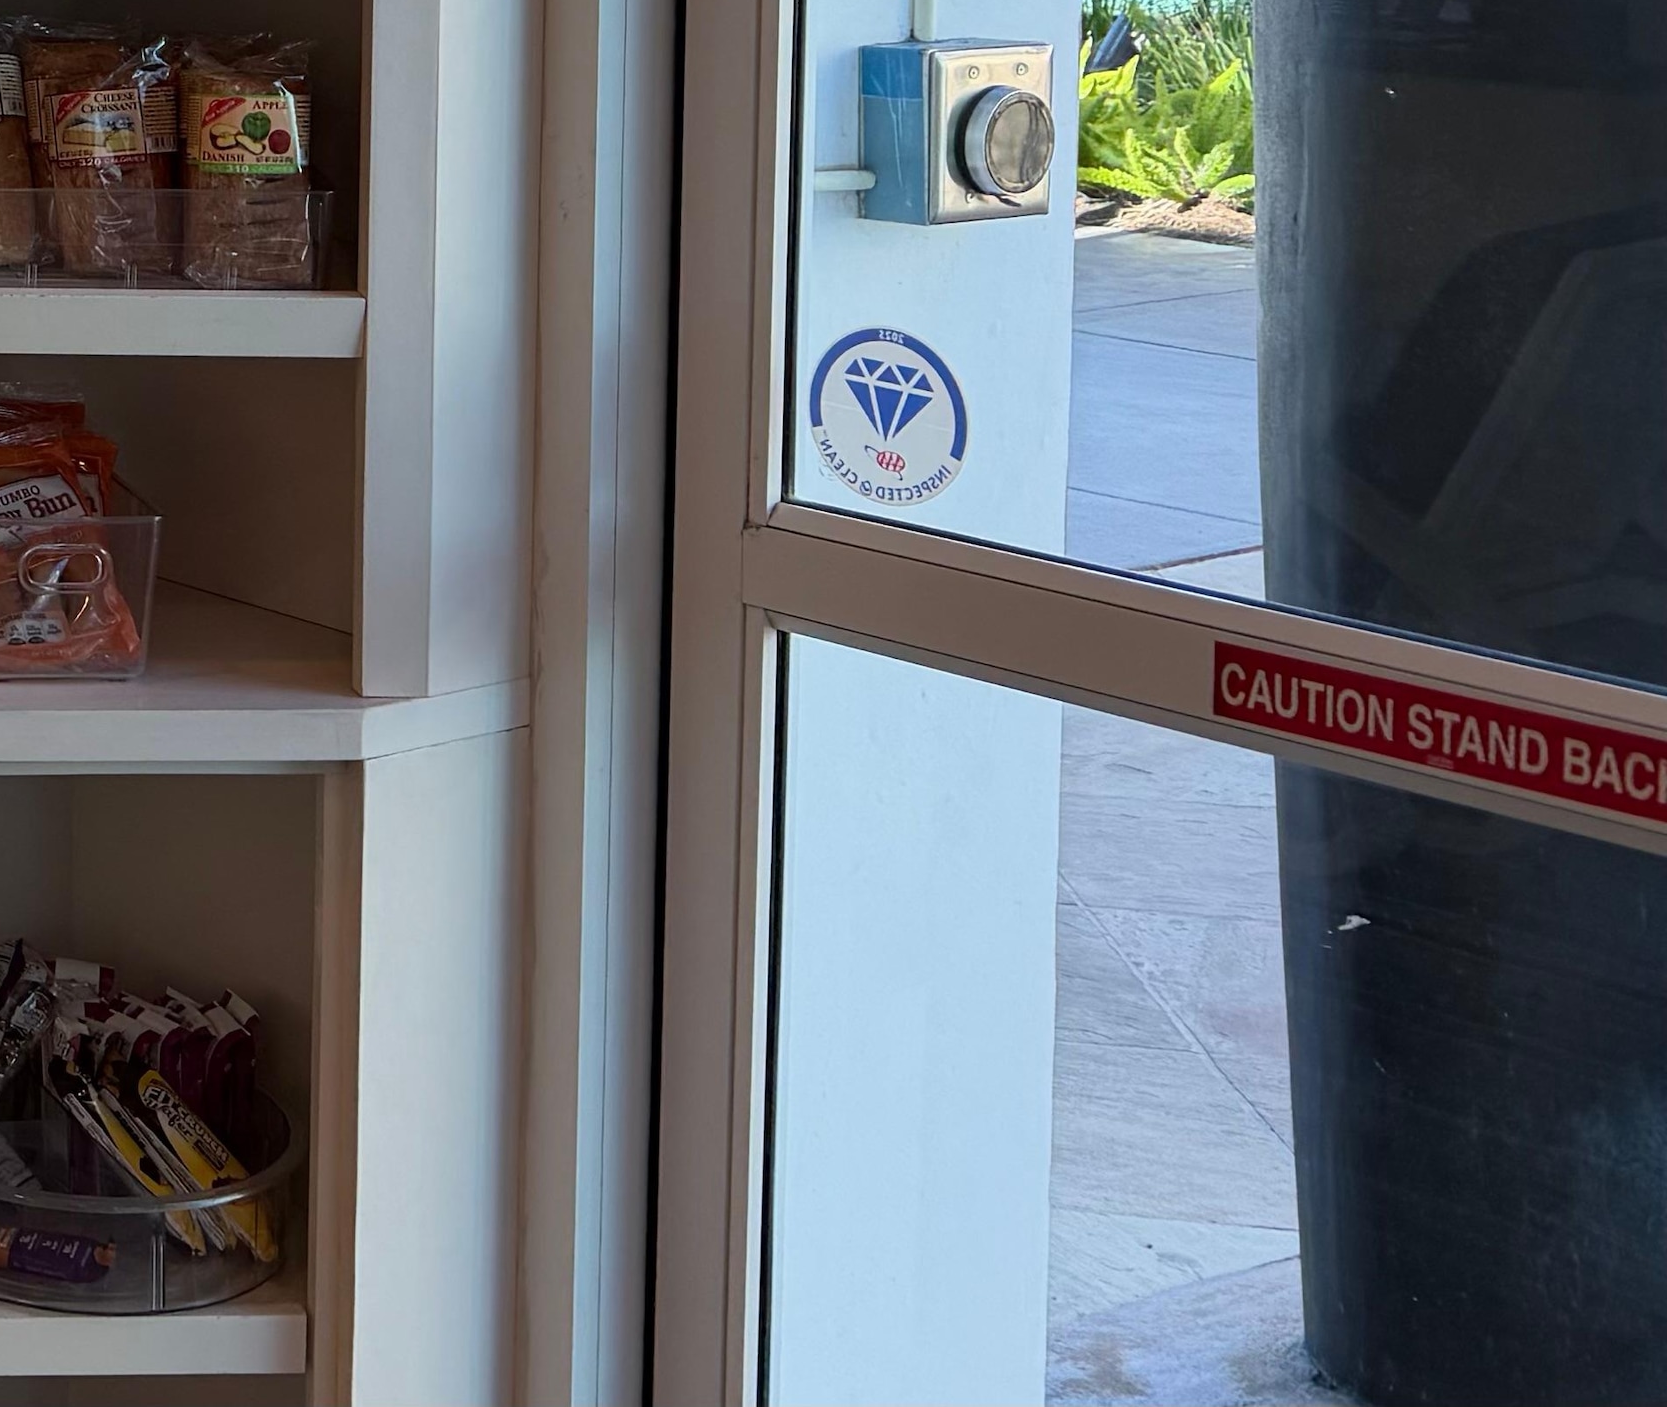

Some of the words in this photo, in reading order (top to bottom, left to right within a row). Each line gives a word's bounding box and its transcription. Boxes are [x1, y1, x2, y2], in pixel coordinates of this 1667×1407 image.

[94, 92, 135, 102] CHEESE
[81, 102, 138, 113] CROISSANT
[78, 157, 101, 167] 320
[202, 151, 244, 162] DANISH
[24, 493, 77, 519] Bun
[1220, 662, 1394, 741] CAUTION
[1407, 703, 1548, 775] STAND
